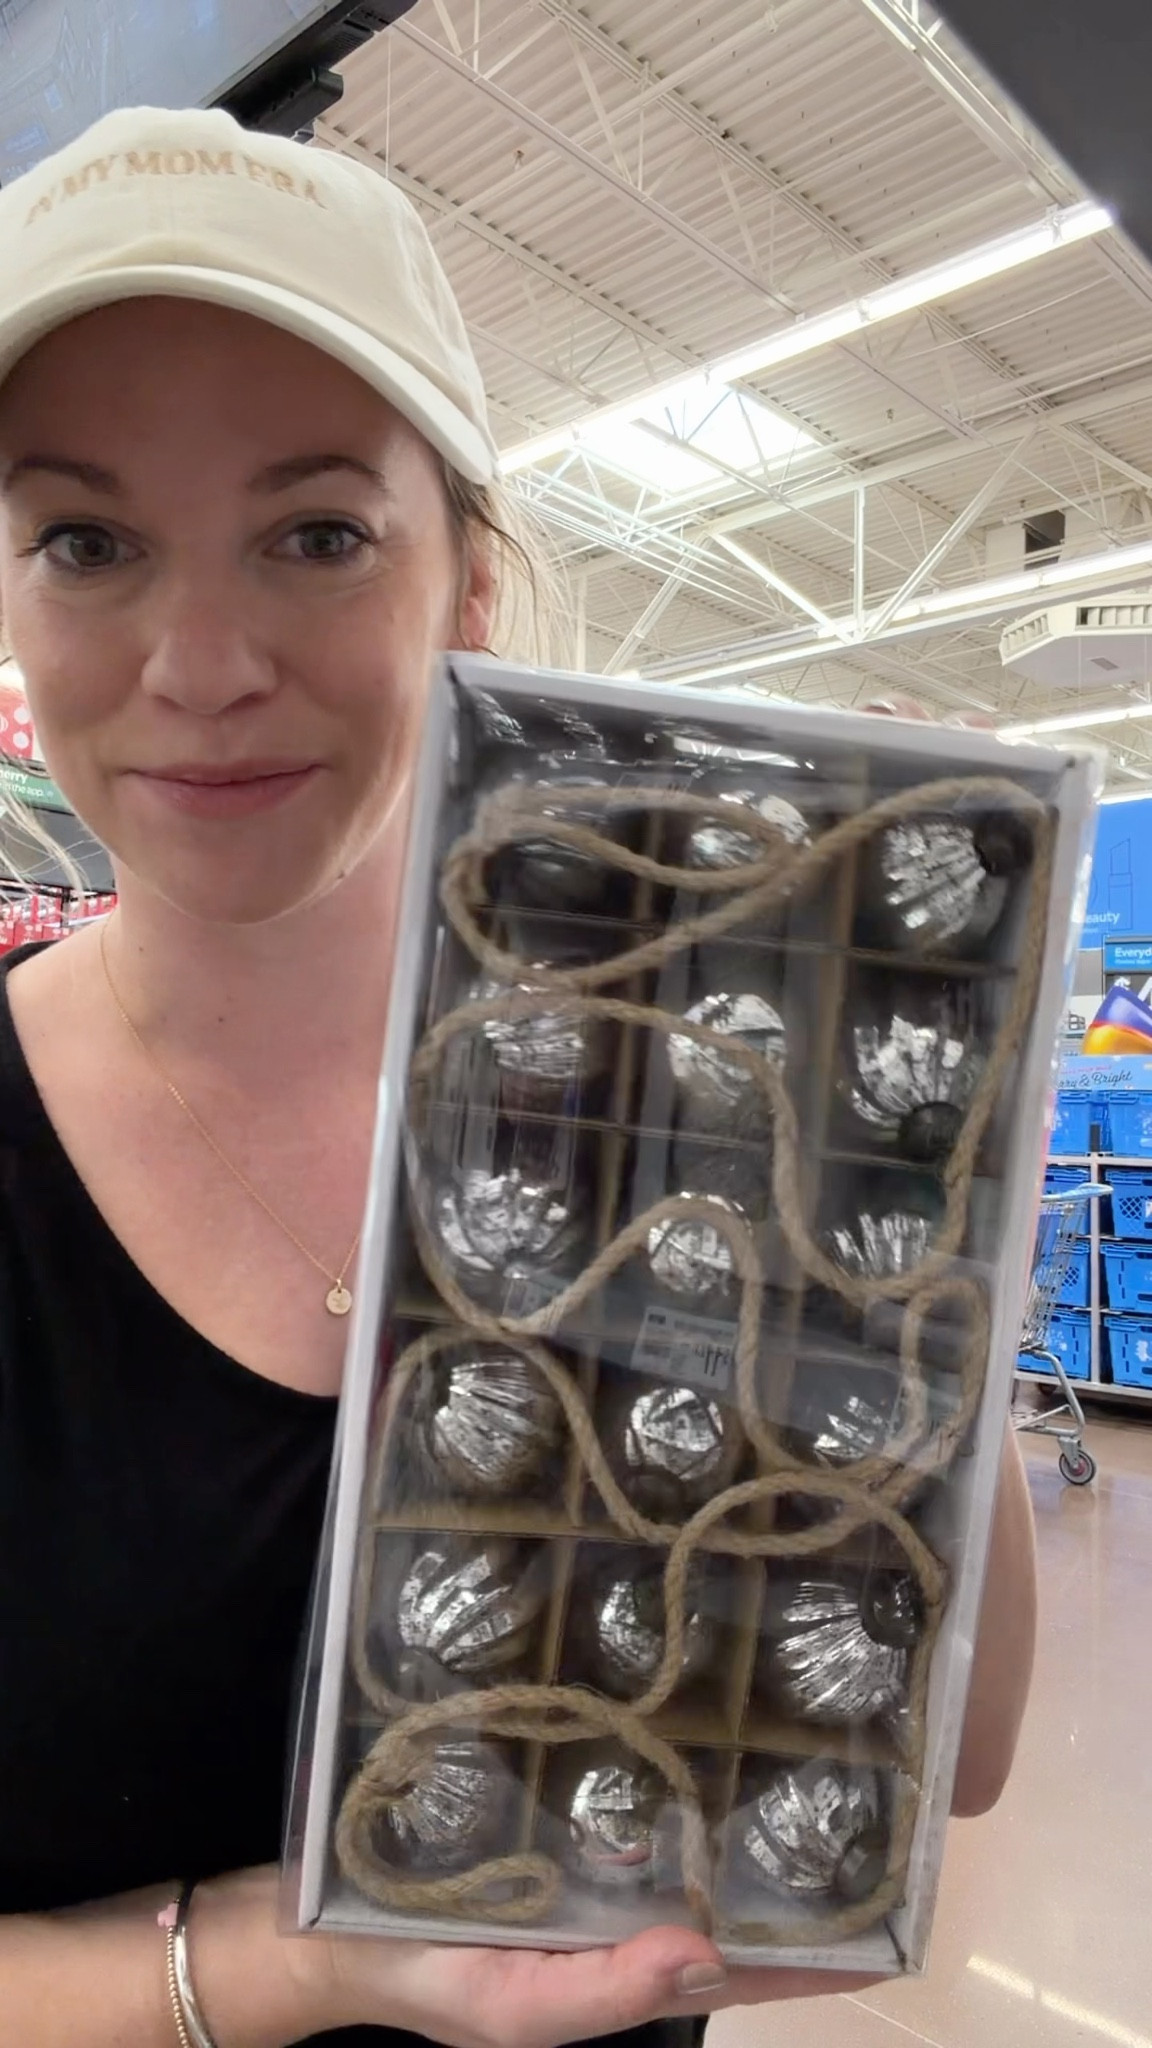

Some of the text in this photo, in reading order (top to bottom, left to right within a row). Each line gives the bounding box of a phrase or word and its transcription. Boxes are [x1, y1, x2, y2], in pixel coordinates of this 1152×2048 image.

[60, 153, 119, 203] MY
[124, 149, 238, 176] MOM
[241, 154, 329, 209] ERA
[1086, 911, 1121, 925] eauty
[1091, 1069, 1133, 1087] Bright
